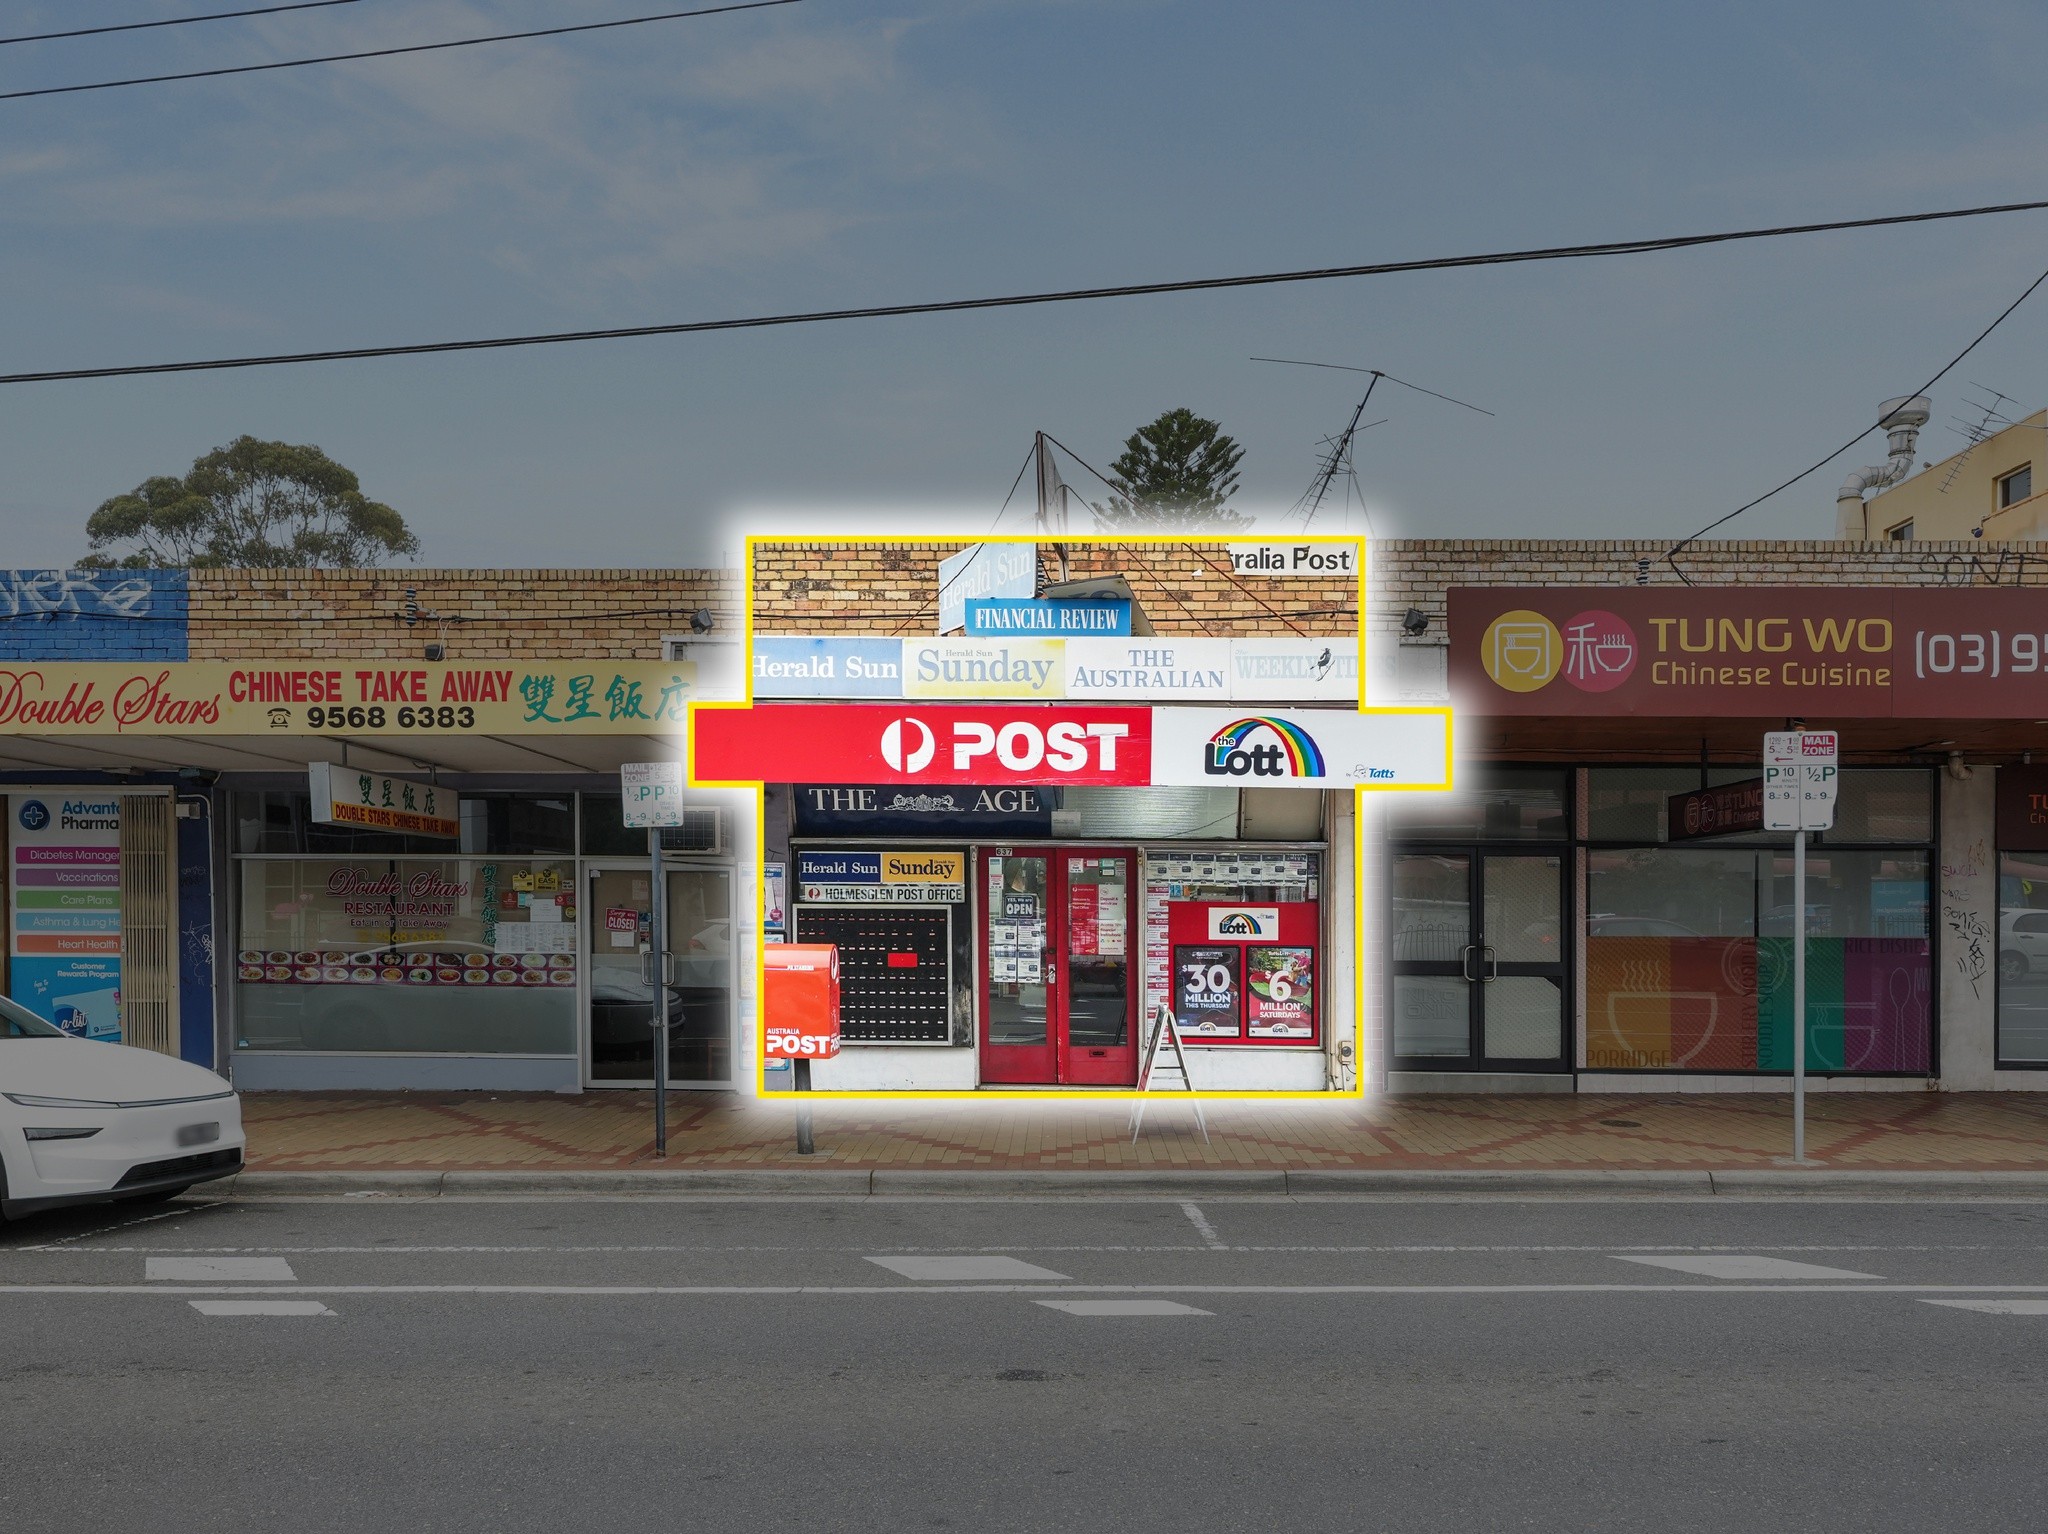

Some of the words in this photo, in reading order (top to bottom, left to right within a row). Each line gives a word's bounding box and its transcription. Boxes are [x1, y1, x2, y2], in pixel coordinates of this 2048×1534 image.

[1230, 547, 1284, 569] ralia
[1294, 546, 1349, 570] Post
[943, 559, 991, 611] Herald
[997, 549, 1032, 586] Sun
[975, 608, 1056, 630] FINANCIAL
[1060, 608, 1119, 630] REVIEW
[1649, 618, 1792, 653] TUNG
[1803, 618, 1893, 653] WO
[1128, 650, 1174, 667] THE
[1916, 630, 2000, 678] (03)
[845, 656, 898, 678] Sun
[917, 649, 1054, 690] Sunday
[1235, 655, 1319, 679] WEEKLY
[1652, 661, 1770, 687] Chinese
[1783, 661, 1891, 687] Cuisine
[229, 671, 341, 702] CHINESE
[356, 671, 427, 702] TAKE
[441, 671, 513, 702] AWAY
[1071, 667, 1225, 688] AUSTRALIAN
[113, 670, 220, 733] Stars
[519, 674, 690, 723] 雙星飯店
[307, 707, 386, 728] 9568
[397, 707, 475, 728] 6383
[953, 721, 1129, 772] POST
[1217, 735, 1235, 747] the
[1804, 737, 1832, 745] MAIL
[1804, 747, 1834, 755] ZONE
[625, 764, 648, 773] MAIL
[1204, 742, 1284, 776] Lott
[625, 774, 649, 782] ZONE
[1369, 768, 1395, 778] Tatts
[1766, 768, 1779, 783] P
[1783, 768, 1795, 777] 10
[808, 789, 877, 811] THE
[972, 789, 1039, 812] AGE
[335, 804, 365, 822] DOUBLE
[368, 809, 390, 826] STARS
[393, 814, 420, 830] CHINESE
[422, 818, 439, 832] TAKE
[441, 821, 456, 835] AWAY
[30, 850, 73, 860] Diabetes
[56, 872, 118, 882] Vaccinations
[802, 862, 846, 874] Herald
[851, 862, 878, 874] Sun
[889, 859, 955, 879] Sunday
[326, 867, 403, 897] Double
[409, 869, 468, 902] Stars
[825, 888, 893, 901] HOLMESGLEN
[897, 888, 923, 901] POST
[927, 888, 962, 901] OFFICE
[61, 895, 84, 904] Care
[87, 895, 113, 904] Plans
[344, 903, 453, 915] RESTAURANT
[1006, 903, 1033, 915] OPEN
[33, 918, 70, 927] Asthma
[73, 918, 80, 927] &
[83, 918, 106, 928] Lung
[351, 919, 380, 927] Eat-in
[399, 919, 418, 927] Take
[424, 919, 448, 929] Away
[609, 917, 634, 930] CLOSED
[1219, 922, 1247, 934] Lott
[58, 940, 84, 949] Heart
[87, 940, 118, 949] Health
[1845, 939, 1875, 954] RICE
[89, 970, 119, 979] Program
[1182, 964, 1231, 994] $30
[1758, 964, 1774, 1005] SOUP
[1265, 970, 1292, 1002] $6
[1185, 993, 1231, 1003] MILLION
[1260, 1002, 1301, 1011] MILLION
[1260, 1011, 1301, 1019] SATURDAYS
[1742, 1002, 1757, 1031] FRY
[767, 1035, 831, 1054] POST
[1758, 1009, 1774, 1069] NOODLE
[1586, 1049, 1671, 1069] PORRIDGE
[1742, 1037, 1757, 1069] STIR
